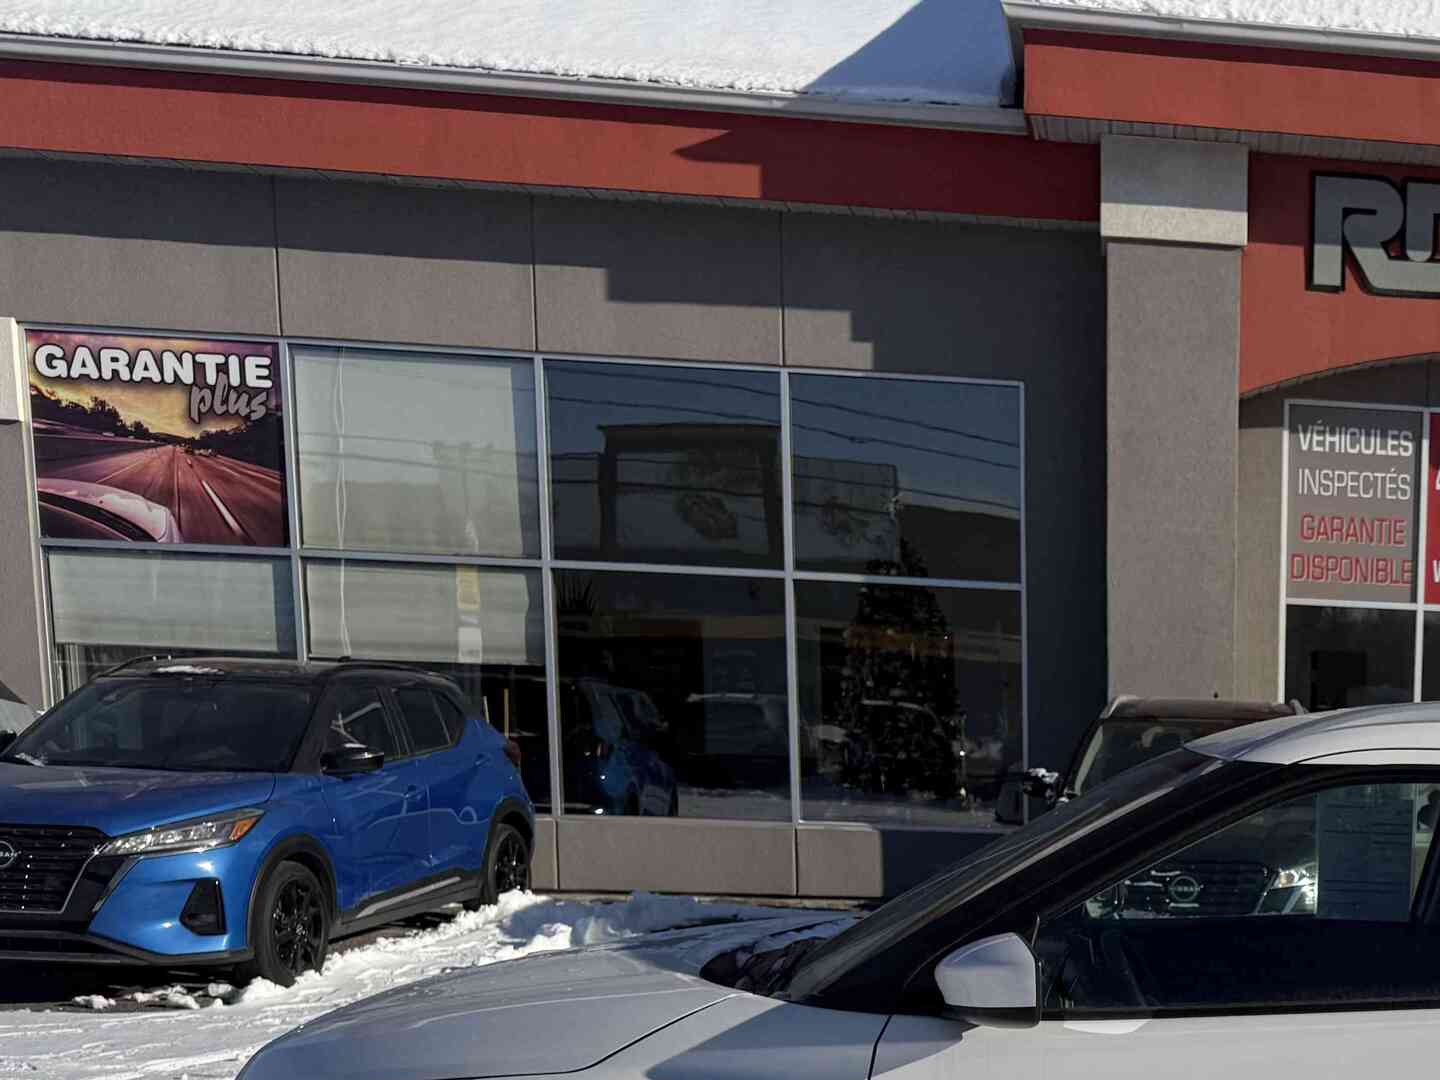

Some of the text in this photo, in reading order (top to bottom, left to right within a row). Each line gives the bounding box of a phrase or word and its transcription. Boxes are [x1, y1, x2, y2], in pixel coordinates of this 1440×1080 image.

[35, 344, 273, 388] GARANTIE
[190, 372, 267, 423] plus
[1298, 420, 1413, 456] VÉHICULES
[1298, 468, 1411, 500] INSPECTÉS
[1301, 514, 1407, 547] GARANTIE
[1291, 554, 1414, 586] DISPONIBLE
